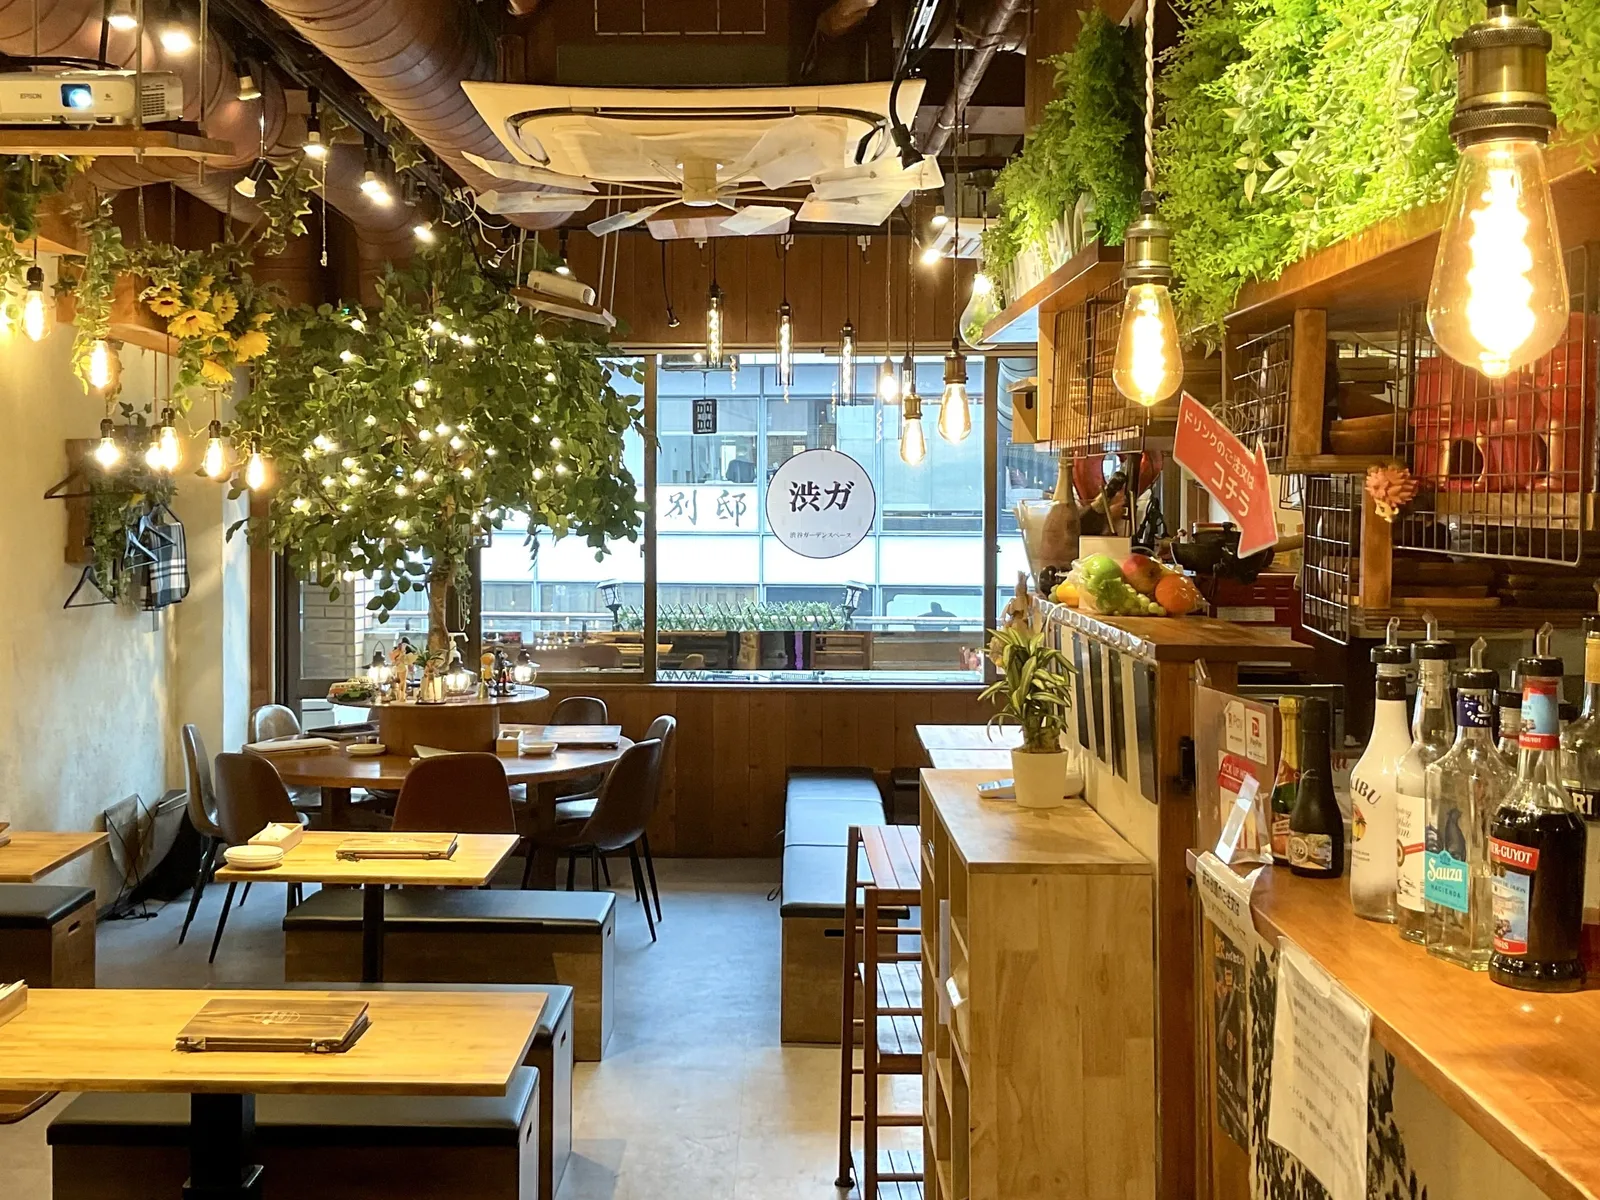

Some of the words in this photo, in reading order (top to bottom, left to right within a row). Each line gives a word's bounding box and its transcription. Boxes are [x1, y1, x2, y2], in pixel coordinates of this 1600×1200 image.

[1184, 409, 1255, 490] ドリンクのご注文は
[789, 481, 855, 513] 渋ガ
[1211, 461, 1250, 517] コチラ
[789, 531, 852, 539] 渋谷ガーデンスペース
[1427, 858, 1463, 882] Sauza
[1431, 884, 1461, 898] HACIENDA
